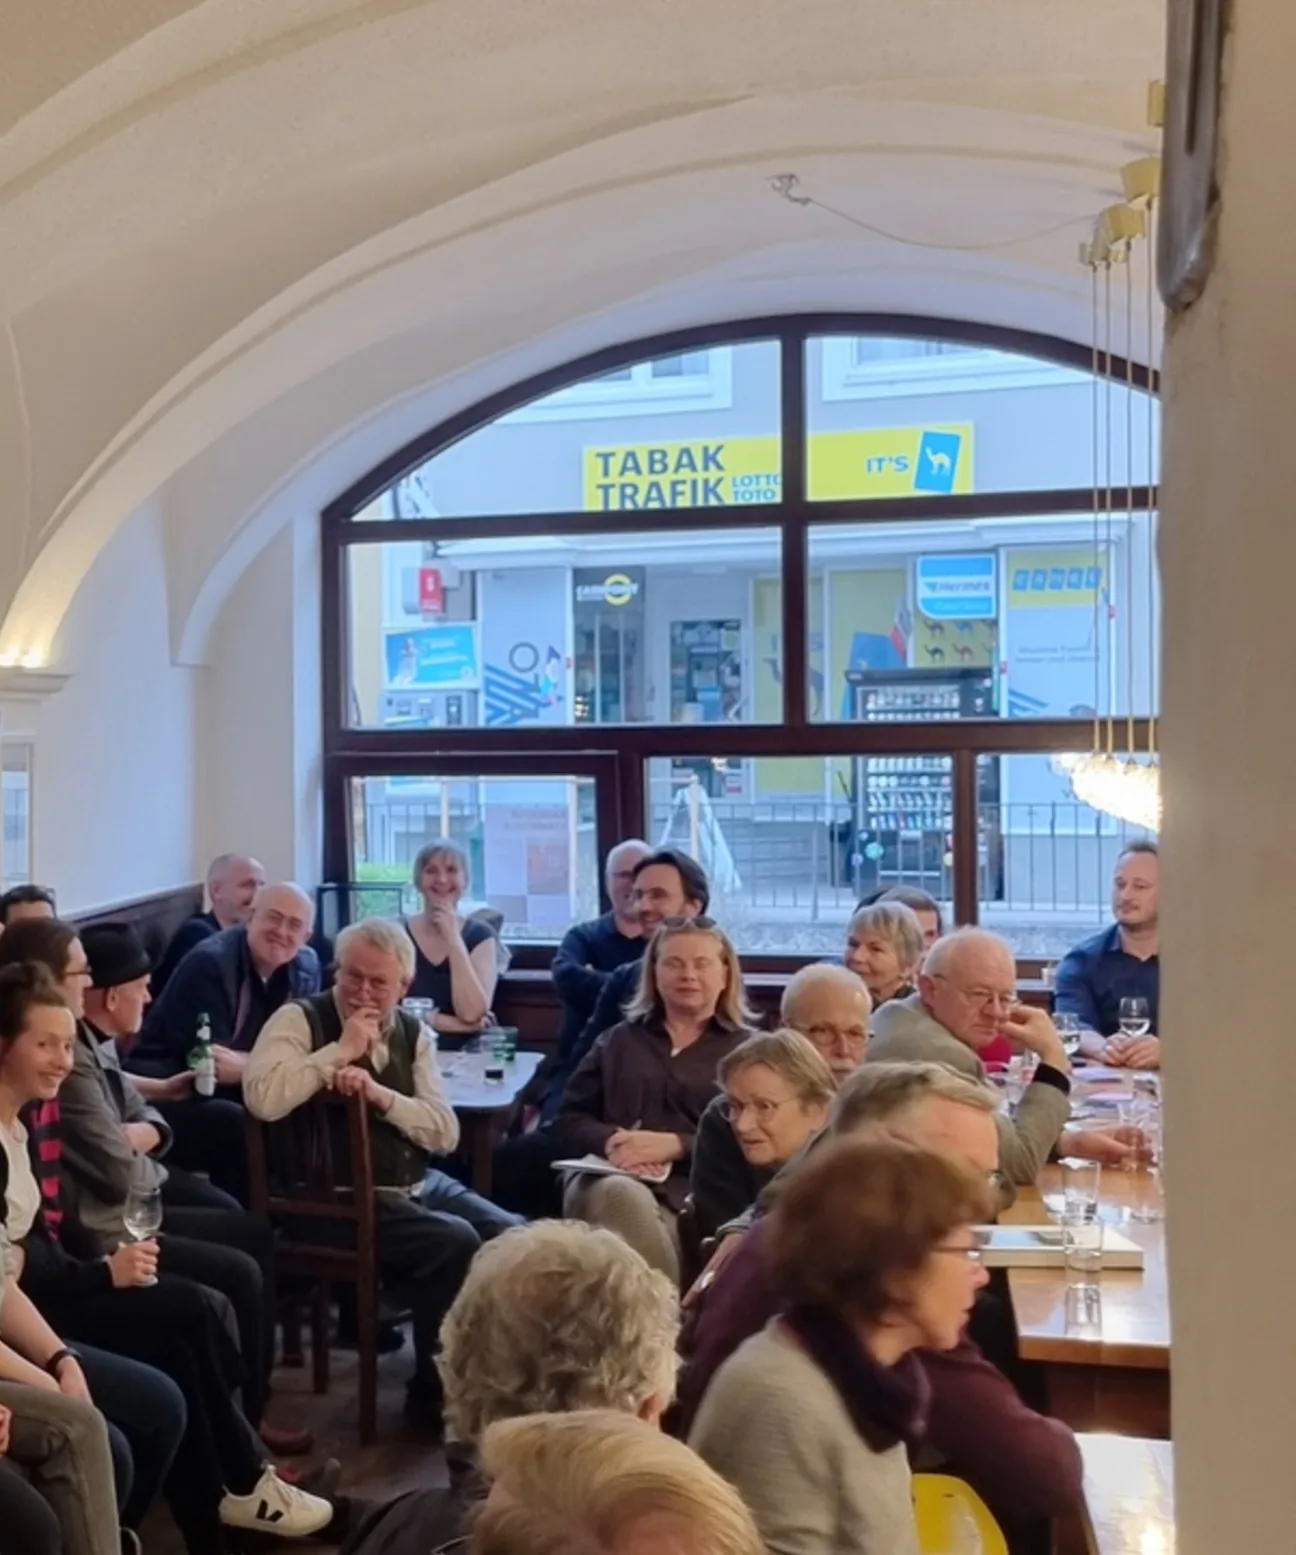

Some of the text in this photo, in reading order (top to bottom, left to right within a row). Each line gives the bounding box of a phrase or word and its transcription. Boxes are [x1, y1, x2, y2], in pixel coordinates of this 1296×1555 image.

[595, 445, 725, 478] TABAK
[867, 456, 909, 473] IT'S
[595, 477, 725, 512] TRAFIK
[733, 488, 776, 502] TOTO
